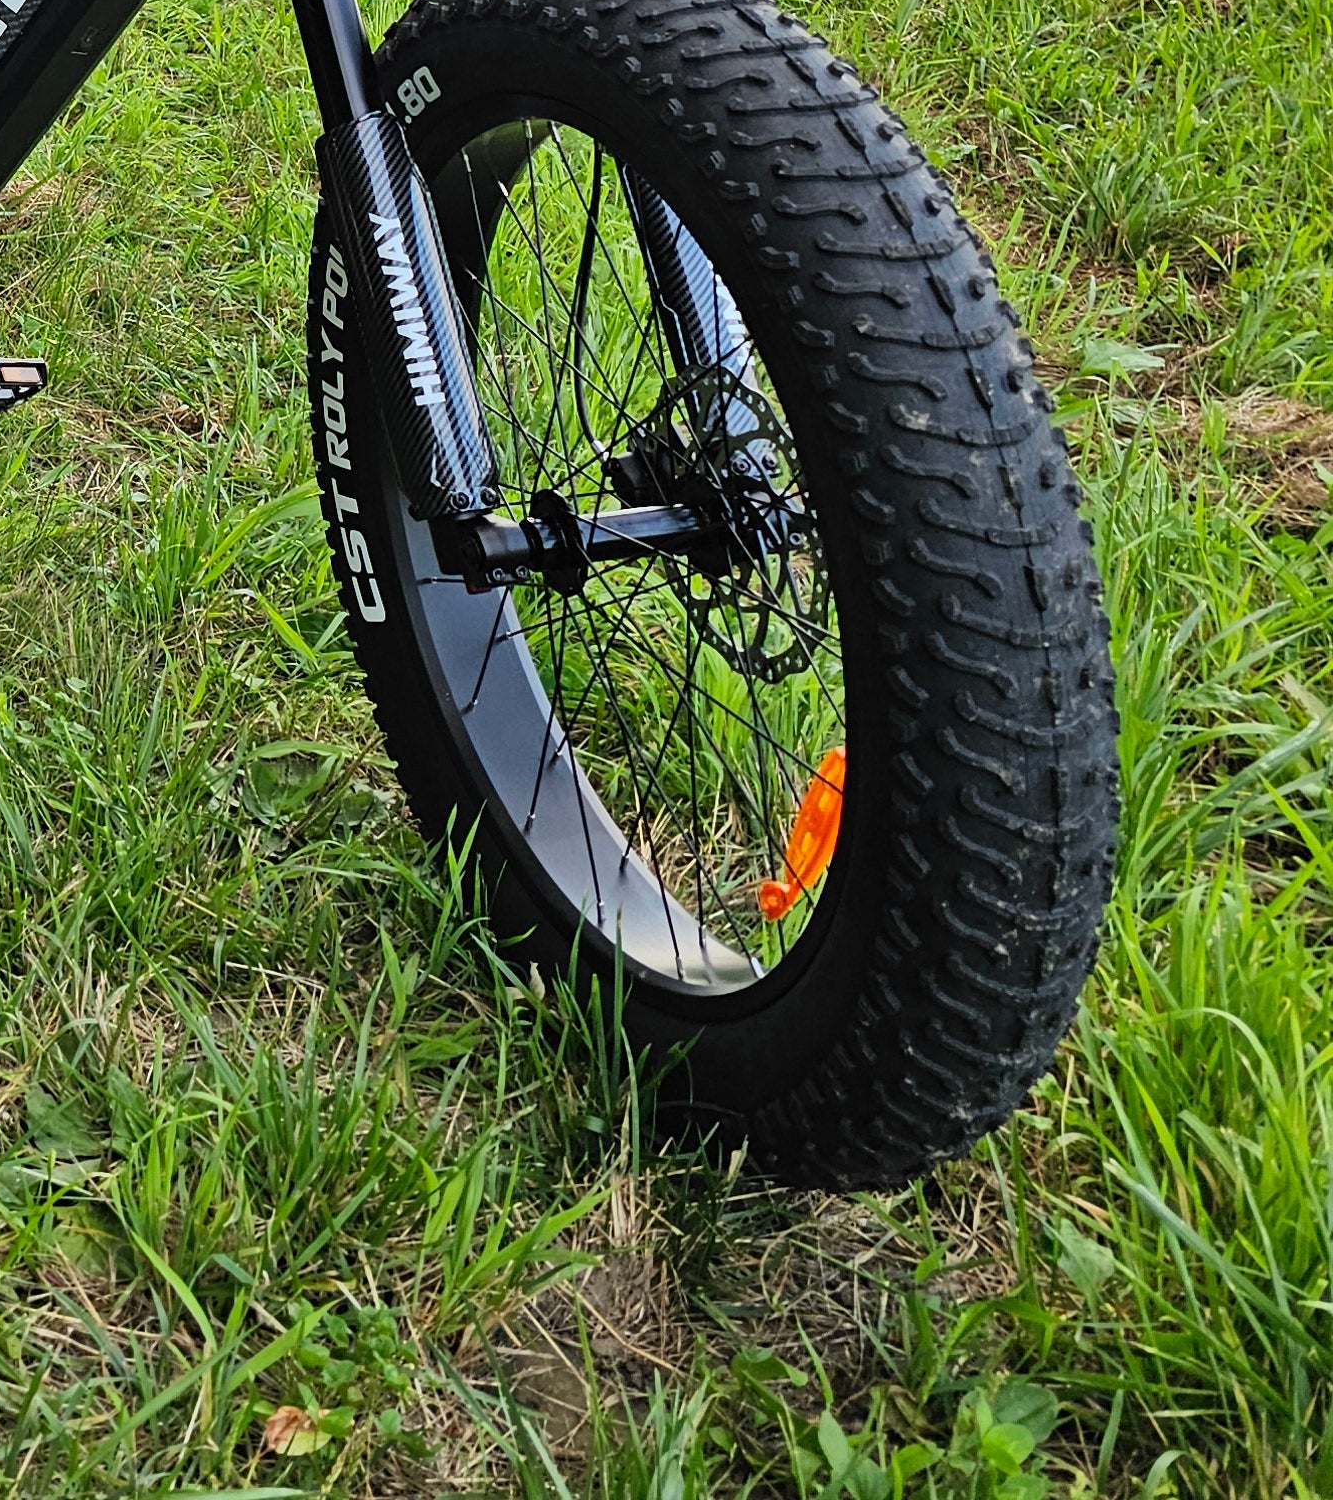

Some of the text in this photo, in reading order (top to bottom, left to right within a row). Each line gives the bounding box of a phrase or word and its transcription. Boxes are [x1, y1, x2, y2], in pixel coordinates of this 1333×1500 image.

[386, 65, 442, 125] .80
[368, 212, 447, 407] HIMIWAY
[321, 325, 352, 471] ROLY
[331, 477, 386, 623] CST
